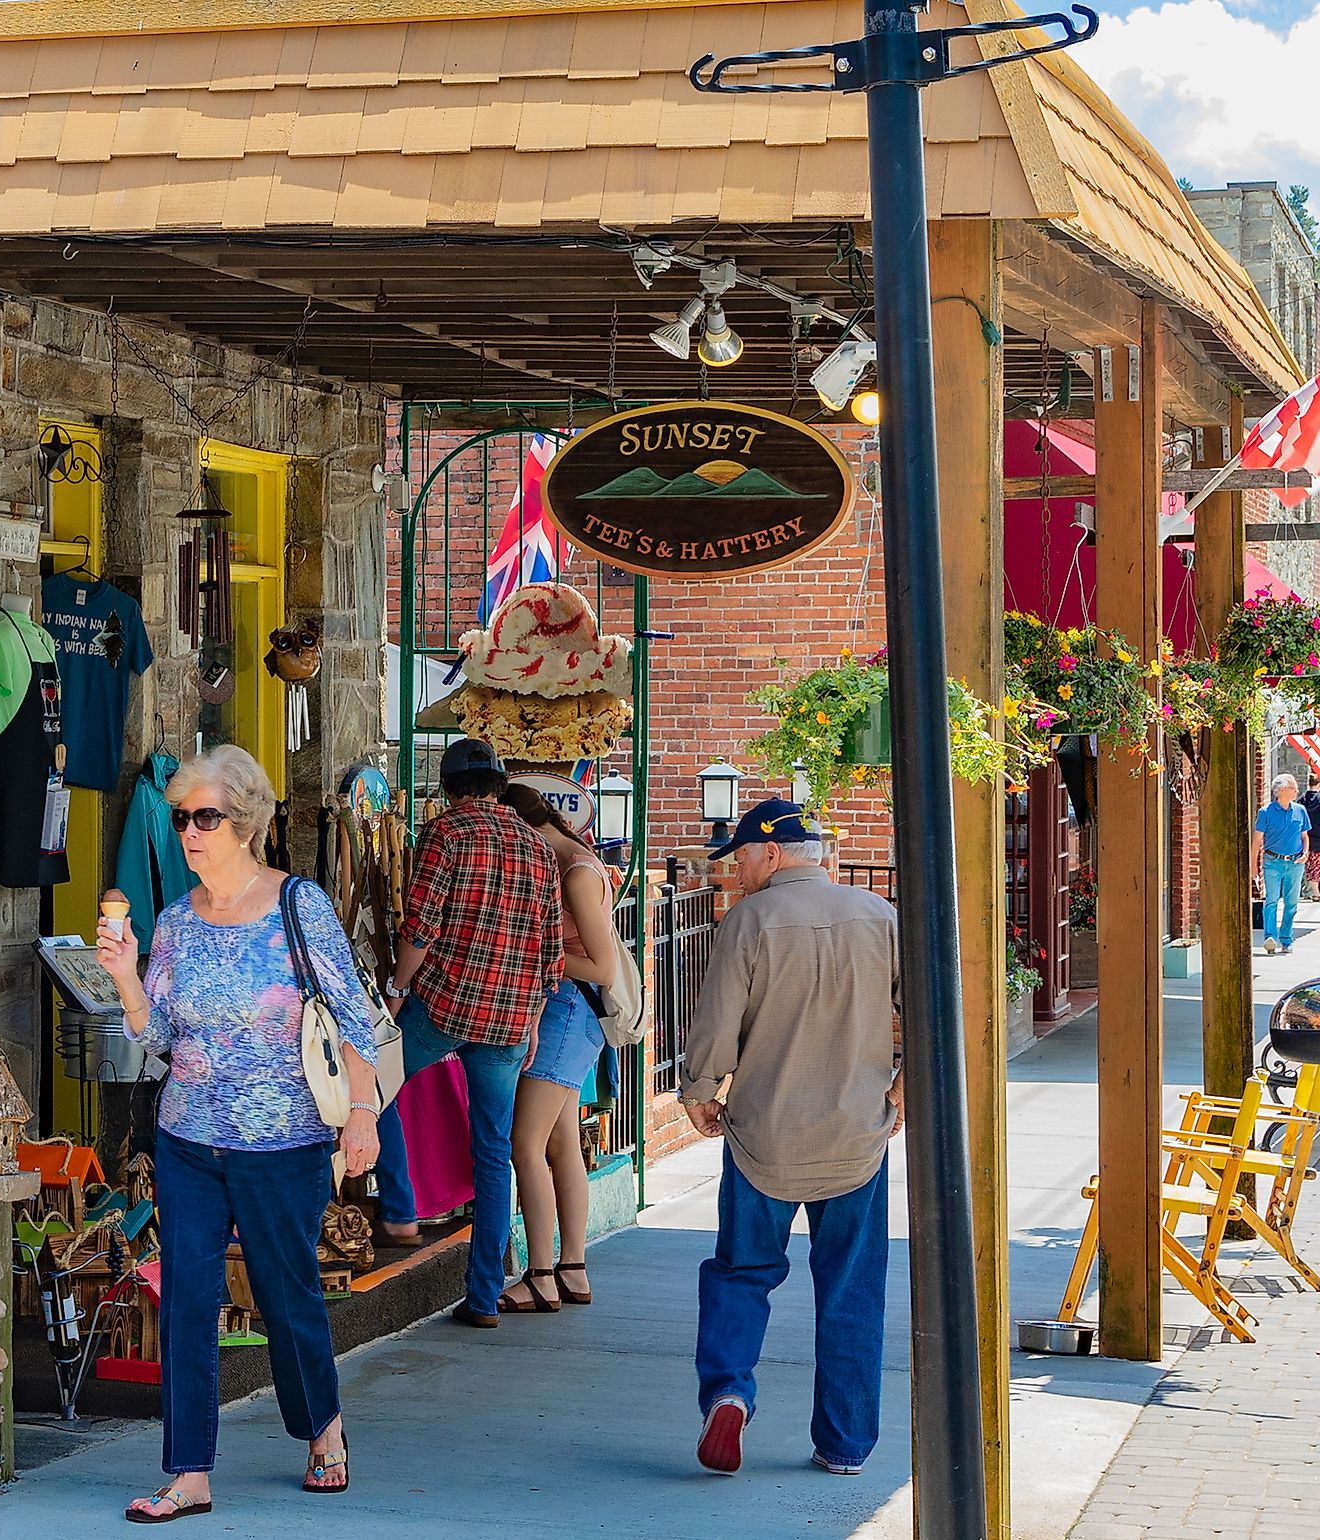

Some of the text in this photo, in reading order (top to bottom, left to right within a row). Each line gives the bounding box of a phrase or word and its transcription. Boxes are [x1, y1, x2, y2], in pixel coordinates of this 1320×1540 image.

[619, 423, 766, 455] SUNSET
[582, 513, 806, 561] TEE'S & HATTERY
[55, 613, 87, 628] INDIAN
[89, 618, 108, 631] NA
[71, 629, 80, 640] IS
[64, 641, 86, 655] WITH
[542, 792, 579, 812] EY'S
